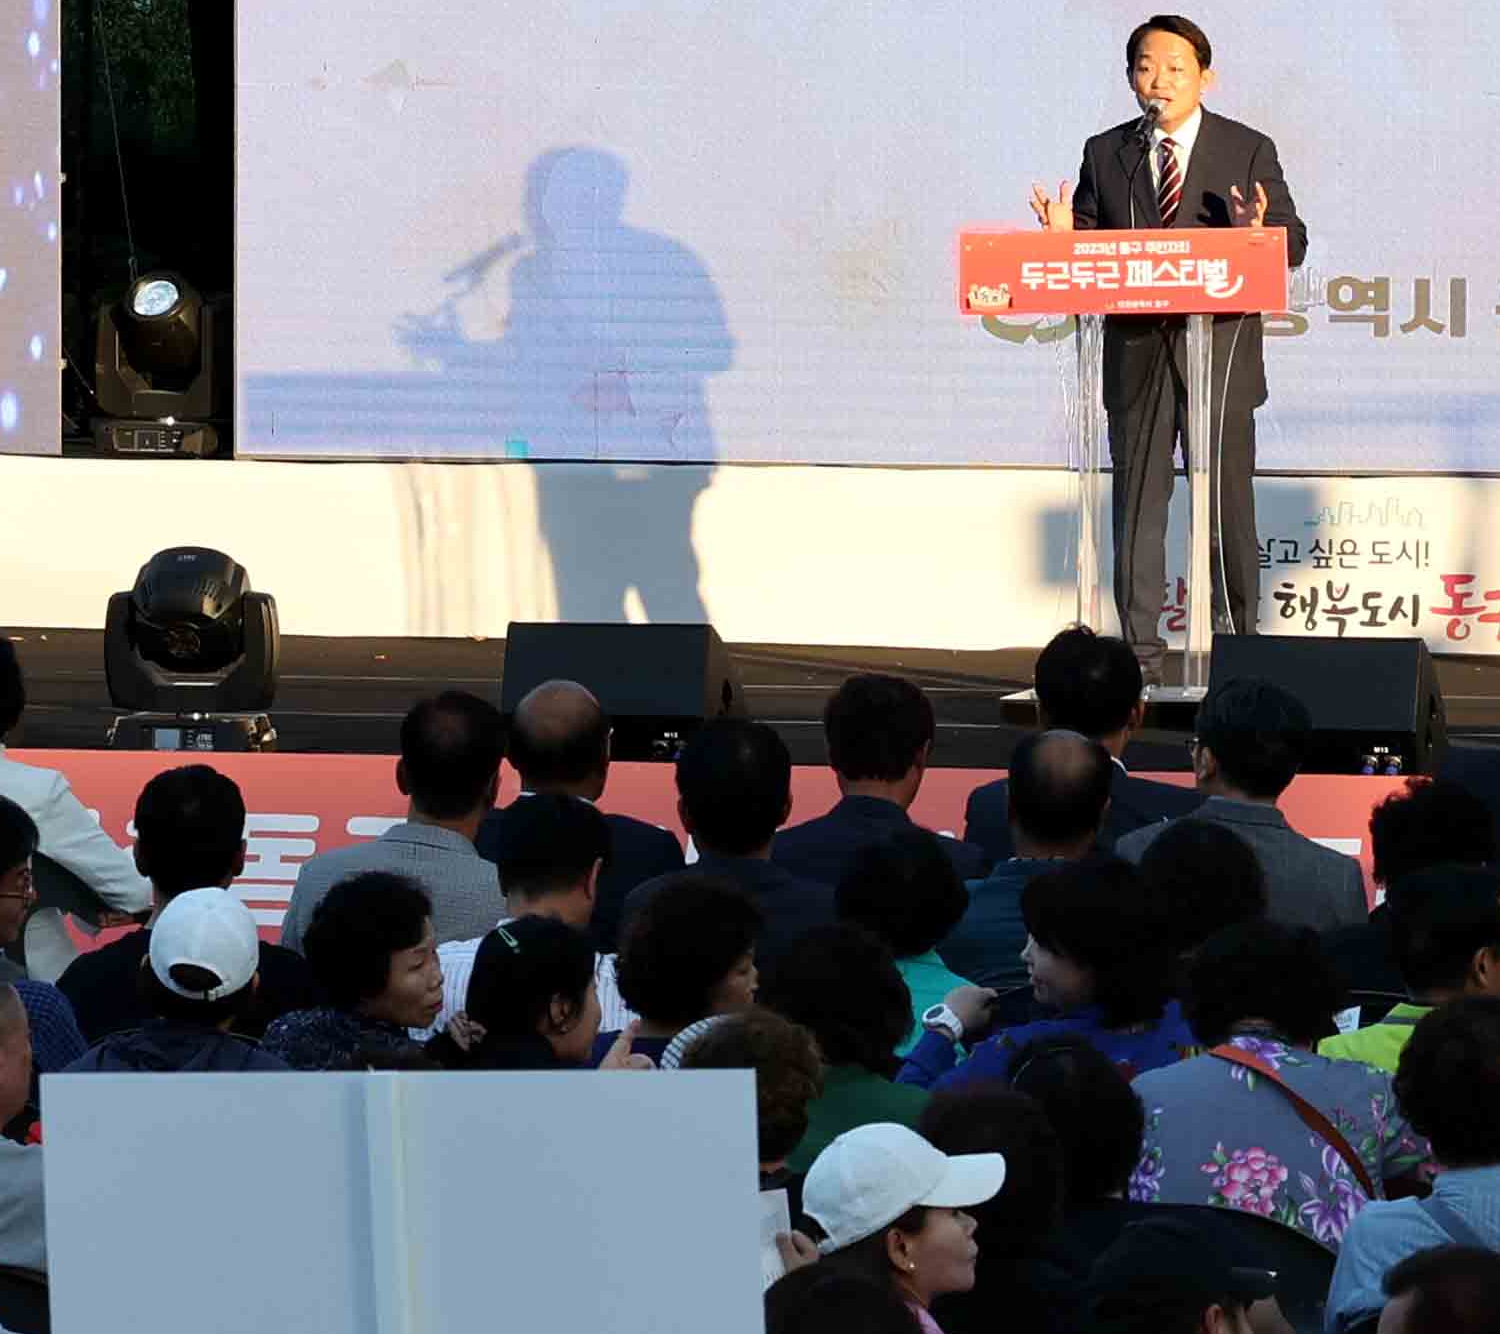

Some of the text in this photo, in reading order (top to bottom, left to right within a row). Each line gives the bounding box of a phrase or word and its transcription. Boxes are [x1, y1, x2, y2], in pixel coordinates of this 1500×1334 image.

[1021, 259, 1243, 299] 두근두근 페스티벌
[1308, 538, 1360, 568] 싶은
[1370, 540, 1430, 567] 도시!
[1273, 580, 1420, 636] 행복도시
